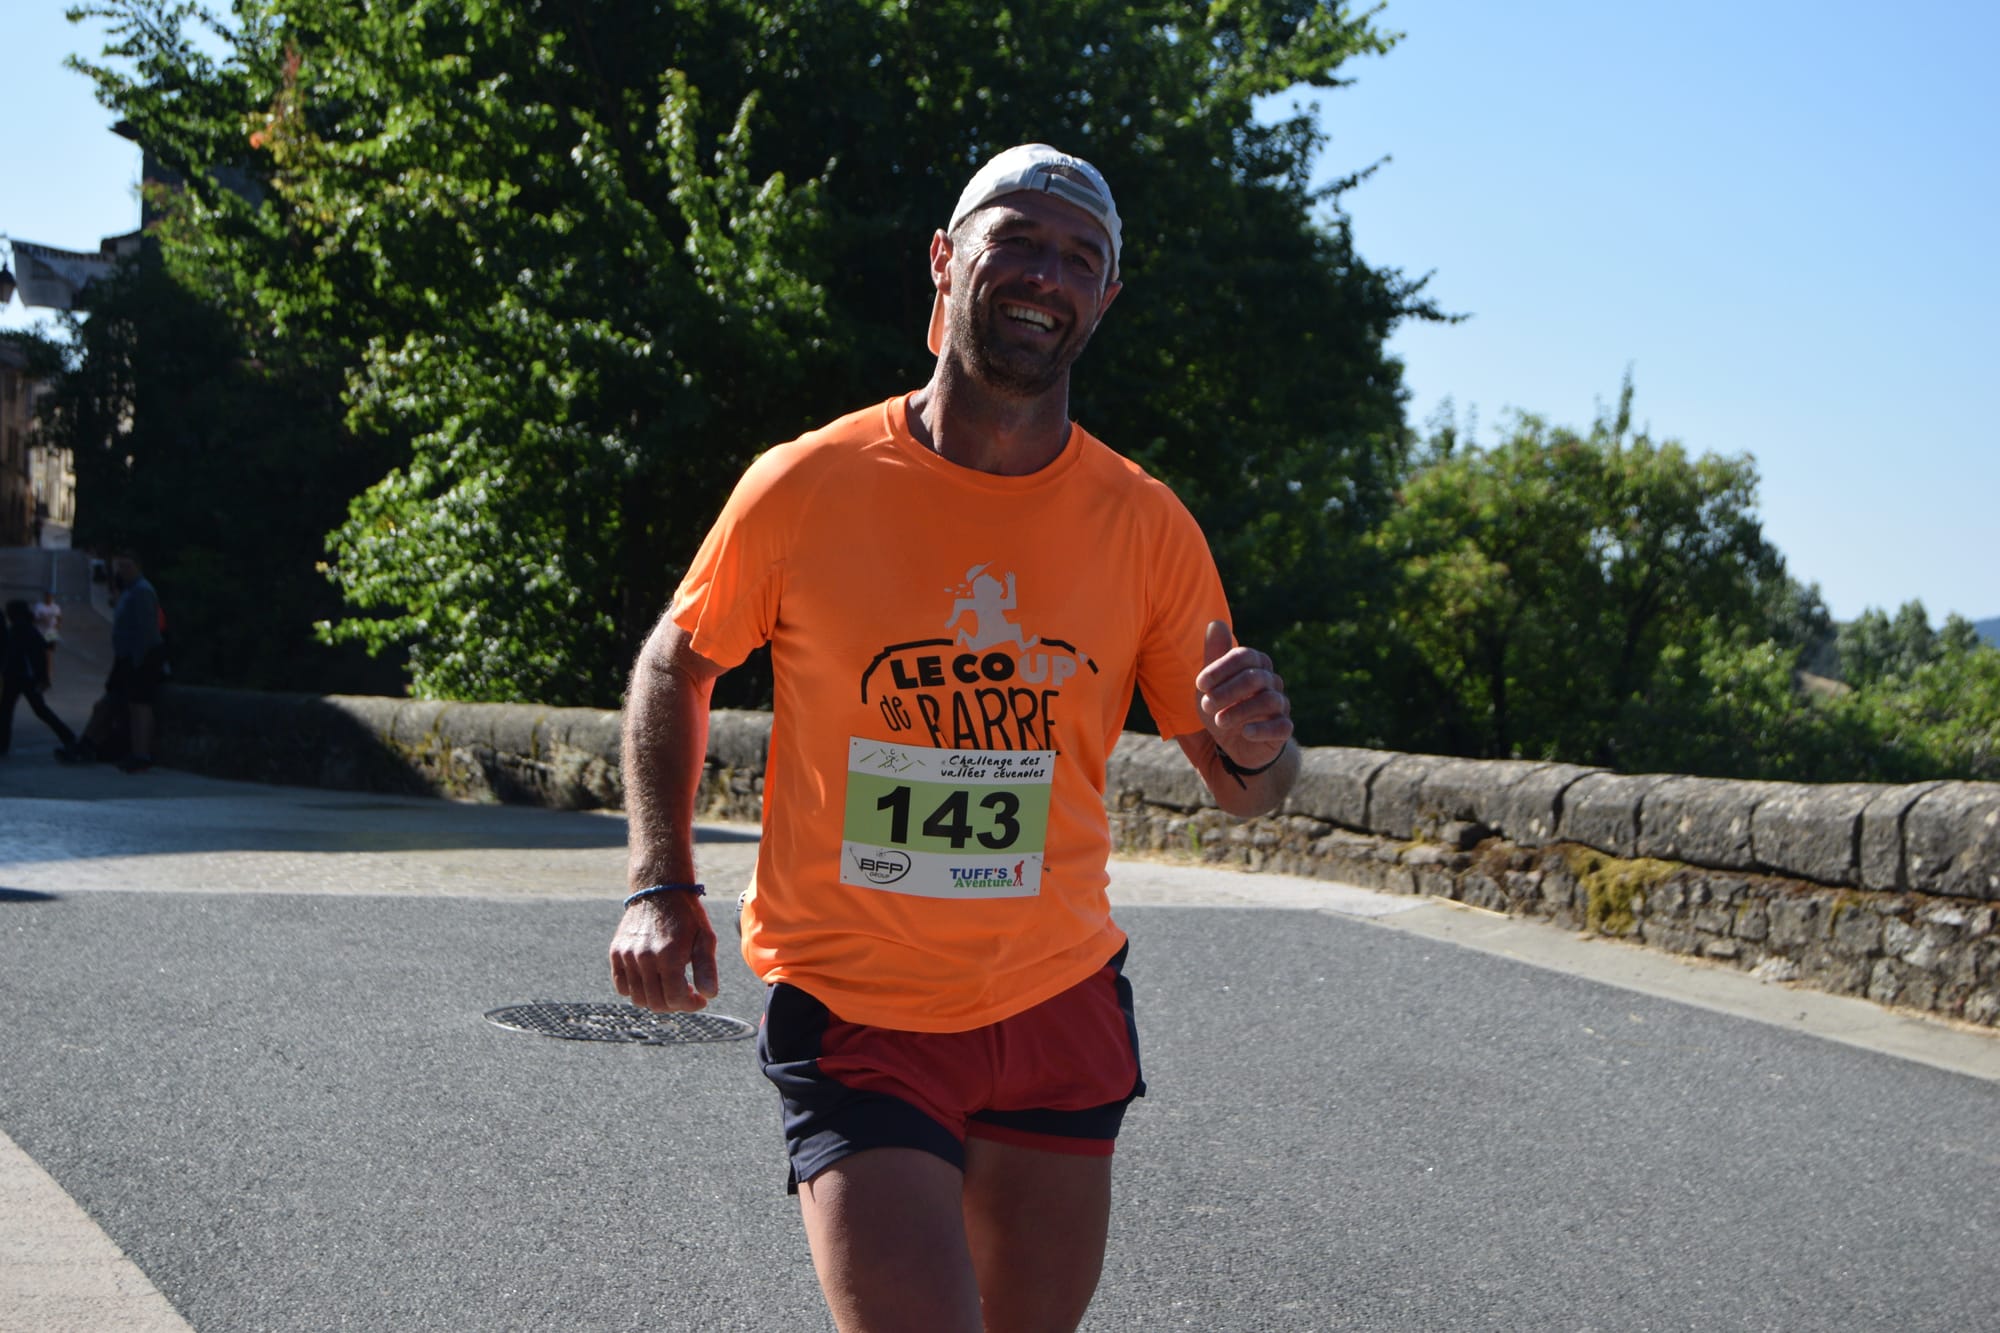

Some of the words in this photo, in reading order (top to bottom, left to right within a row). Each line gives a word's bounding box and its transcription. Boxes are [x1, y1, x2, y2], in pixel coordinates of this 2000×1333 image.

[890, 655, 945, 690] LE
[952, 652, 1077, 686] COUP
[880, 694, 911, 732] de
[949, 755, 1013, 769] Challenge
[1020, 756, 1040, 766] des
[941, 766, 986, 778] vallées
[993, 767, 1045, 779] cévenoles
[877, 785, 1021, 850] 143
[860, 858, 904, 874] BFP
[949, 868, 1008, 880] TUFF'S
[954, 877, 1013, 888] Aventure
